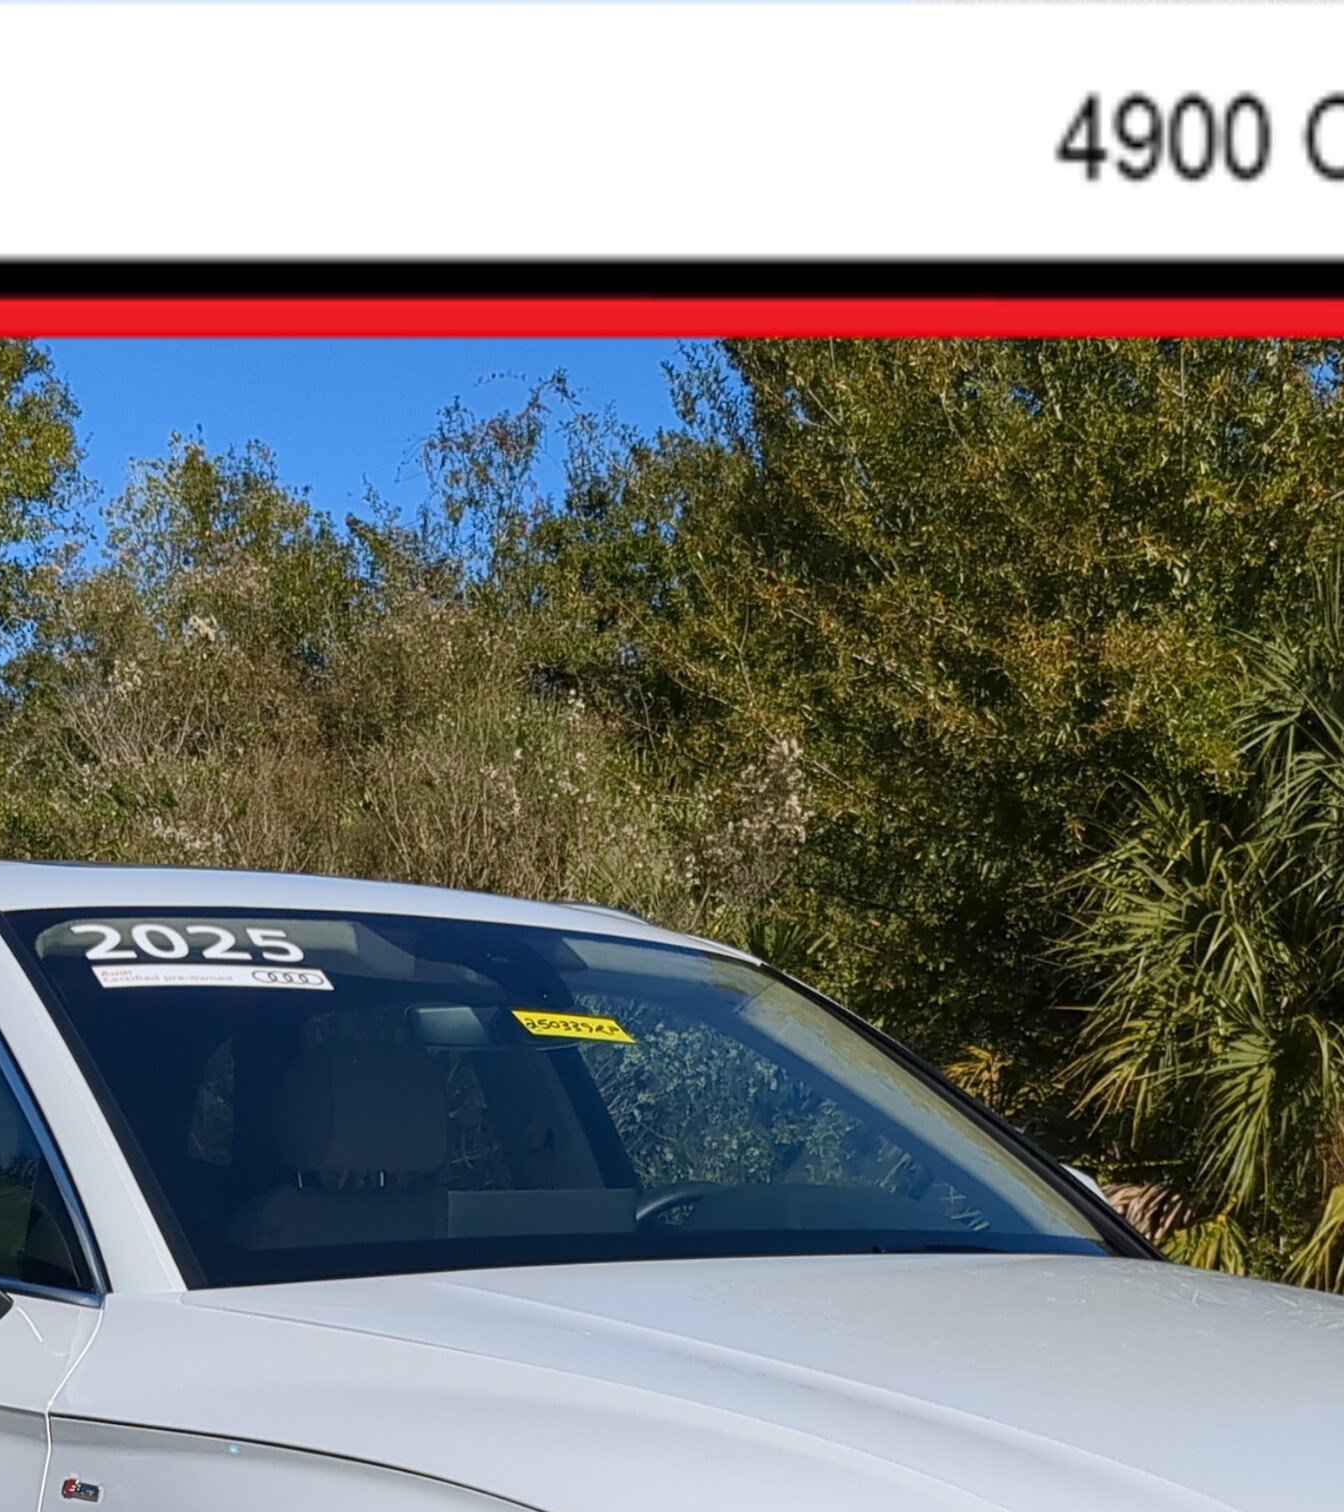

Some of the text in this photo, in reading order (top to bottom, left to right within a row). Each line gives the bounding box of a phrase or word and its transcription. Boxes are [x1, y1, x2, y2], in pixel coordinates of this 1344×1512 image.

[70, 923, 304, 963] 2025
[100, 969, 132, 977] Audi
[102, 974, 160, 983] Certified
